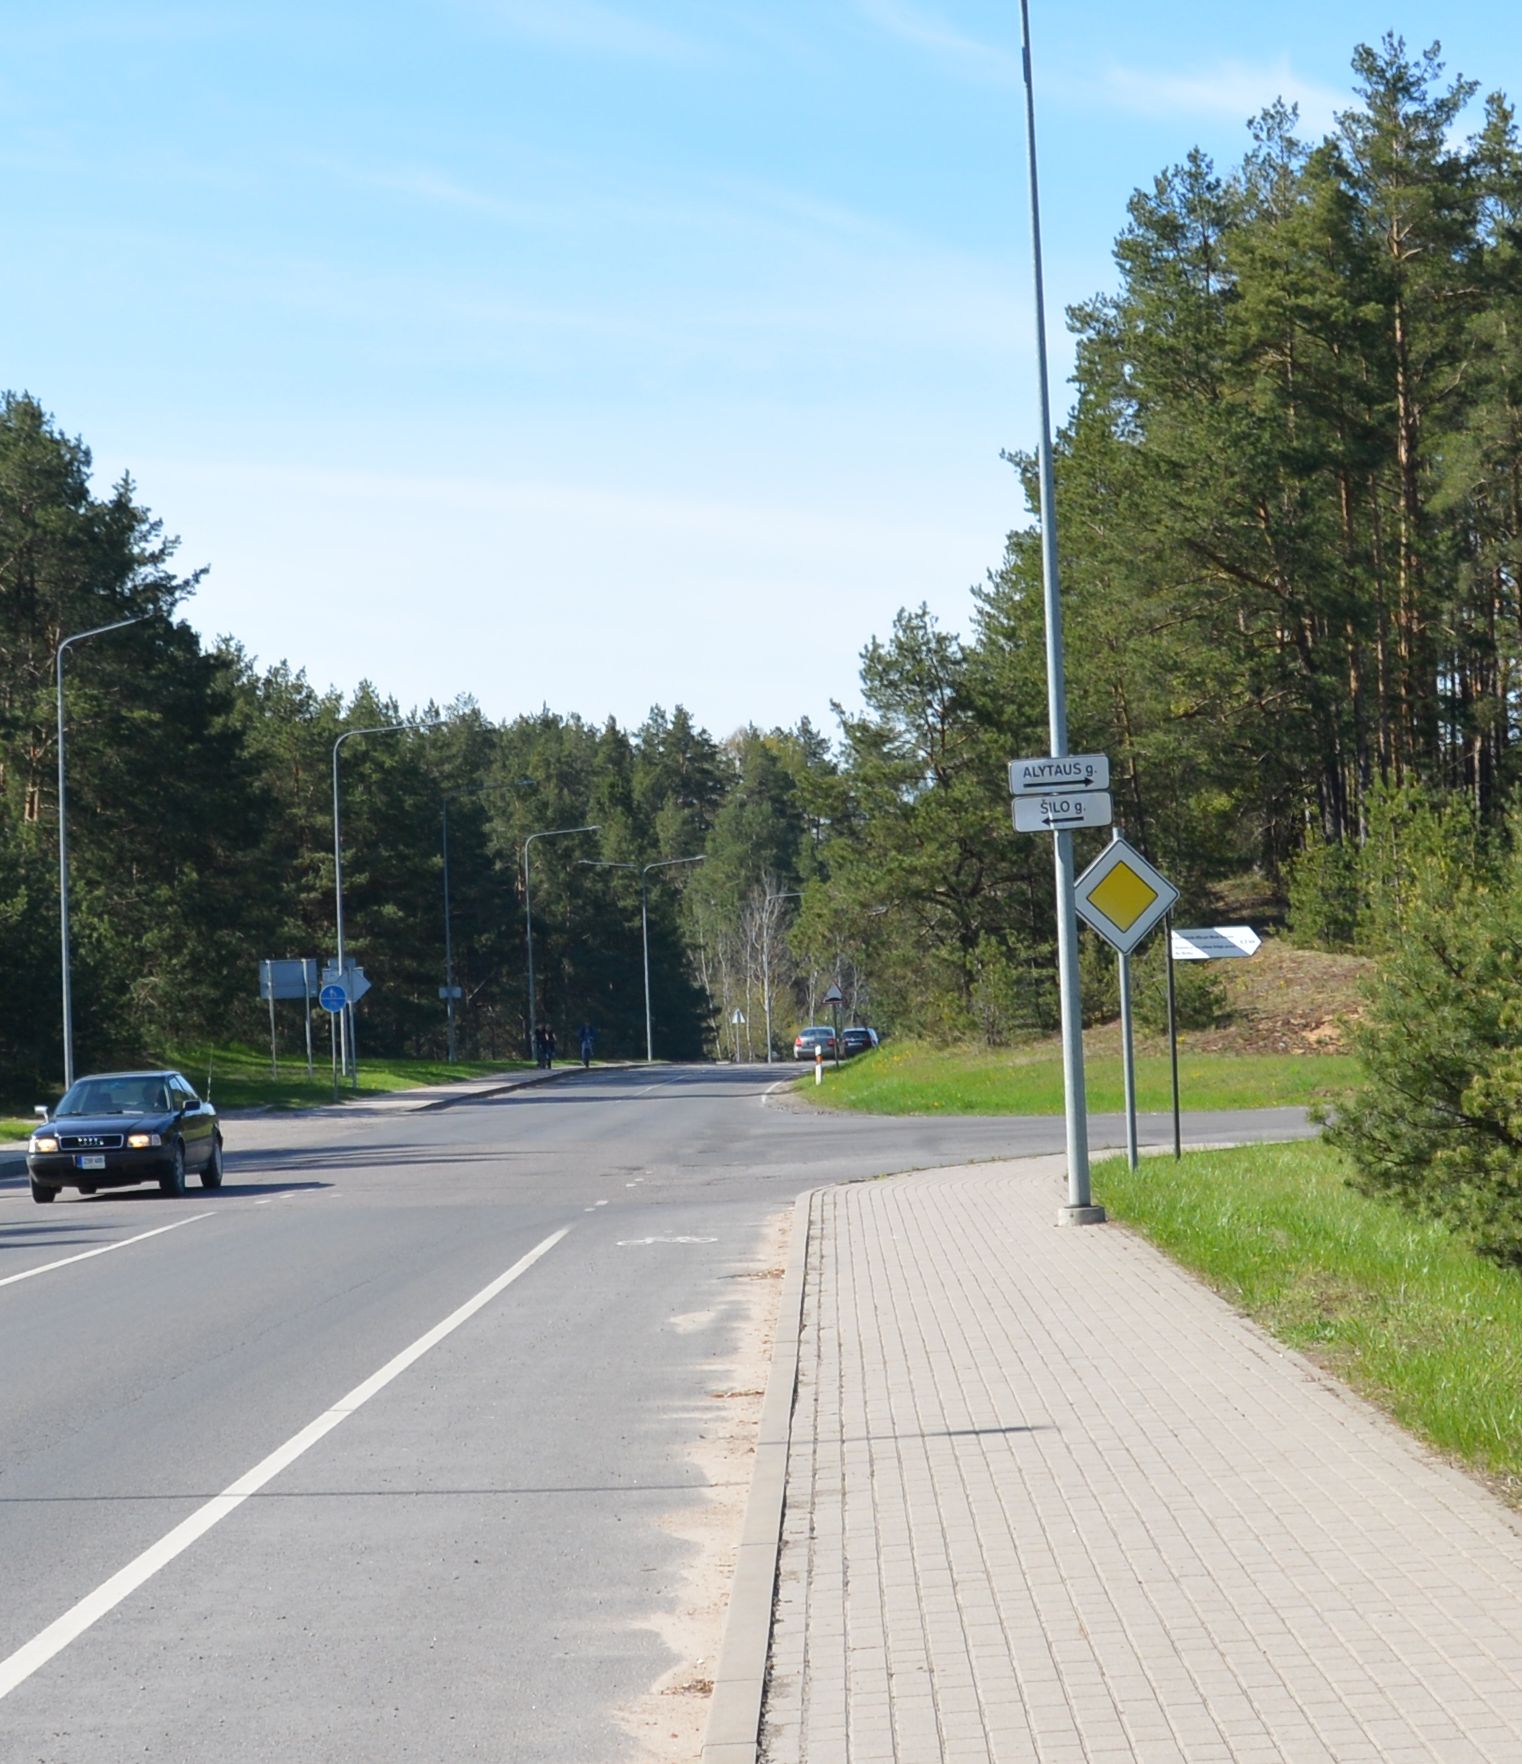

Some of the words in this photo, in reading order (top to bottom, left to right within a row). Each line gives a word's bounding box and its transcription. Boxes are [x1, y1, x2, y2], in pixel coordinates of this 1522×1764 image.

[1023, 762, 1082, 778] ALYTAUS
[1085, 764, 1098, 777] g.
[1040, 799, 1070, 814] ŠILO
[1074, 802, 1086, 815] g.
